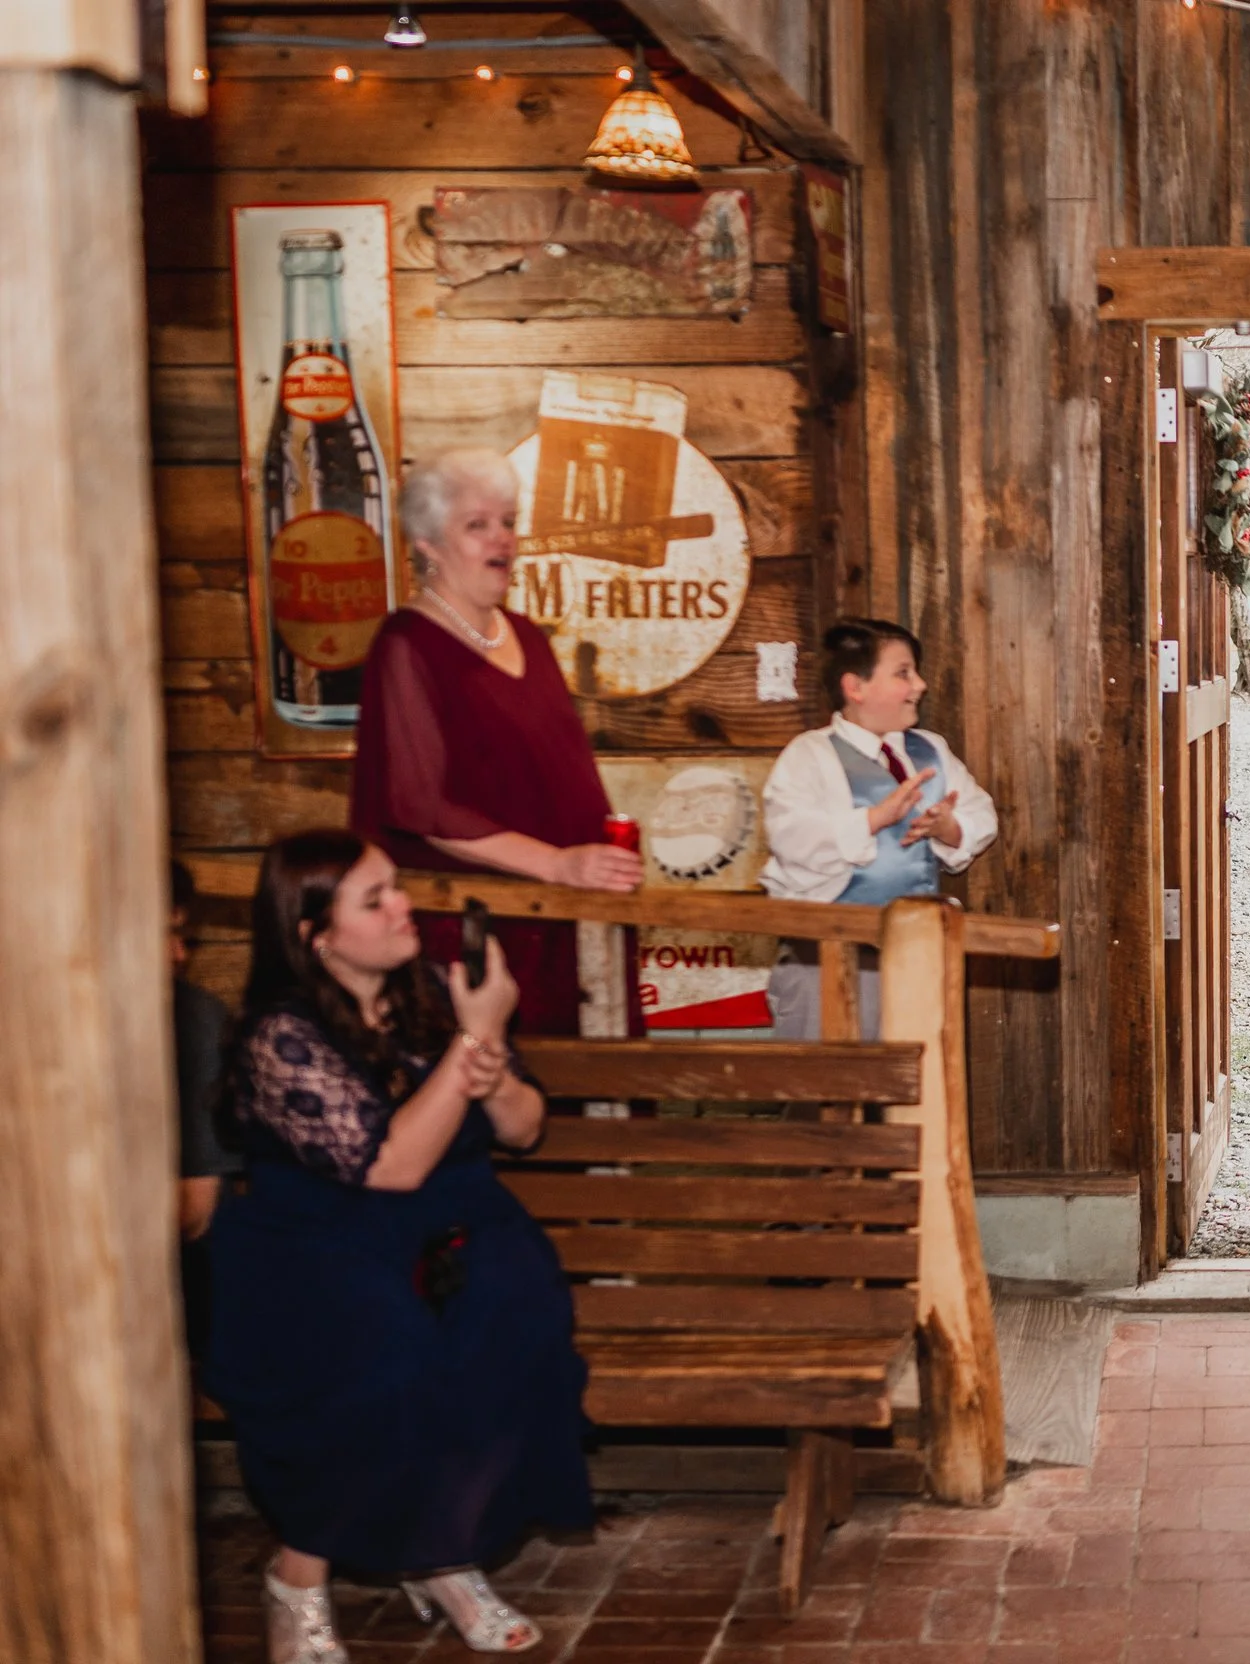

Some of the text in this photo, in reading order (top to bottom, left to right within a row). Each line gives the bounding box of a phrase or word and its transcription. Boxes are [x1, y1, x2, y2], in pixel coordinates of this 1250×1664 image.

[283, 539, 308, 558] 10
[585, 579, 729, 619] FILTERS
[639, 945, 735, 969] rown
